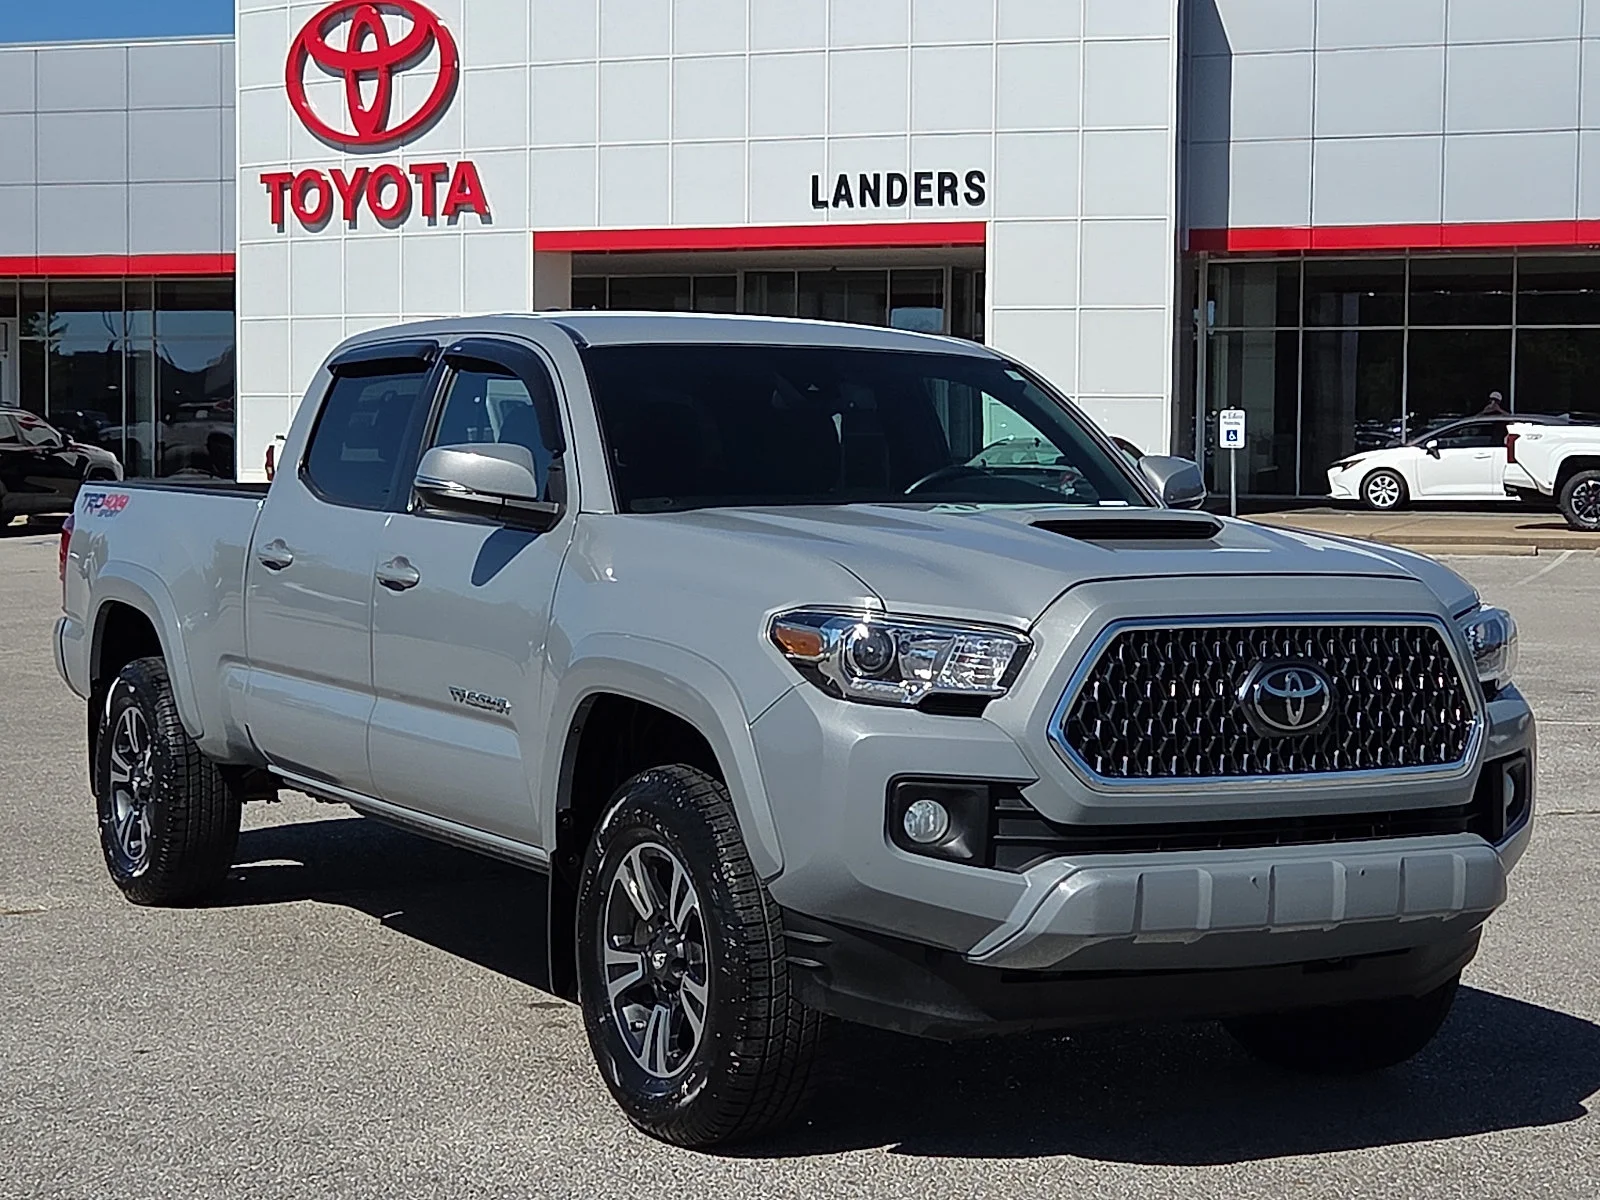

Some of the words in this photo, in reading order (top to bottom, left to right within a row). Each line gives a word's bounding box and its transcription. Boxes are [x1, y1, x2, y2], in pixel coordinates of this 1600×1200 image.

[260, 161, 491, 232] TOYOTA
[811, 170, 986, 209] LANDERS
[82, 493, 106, 515] TRD
